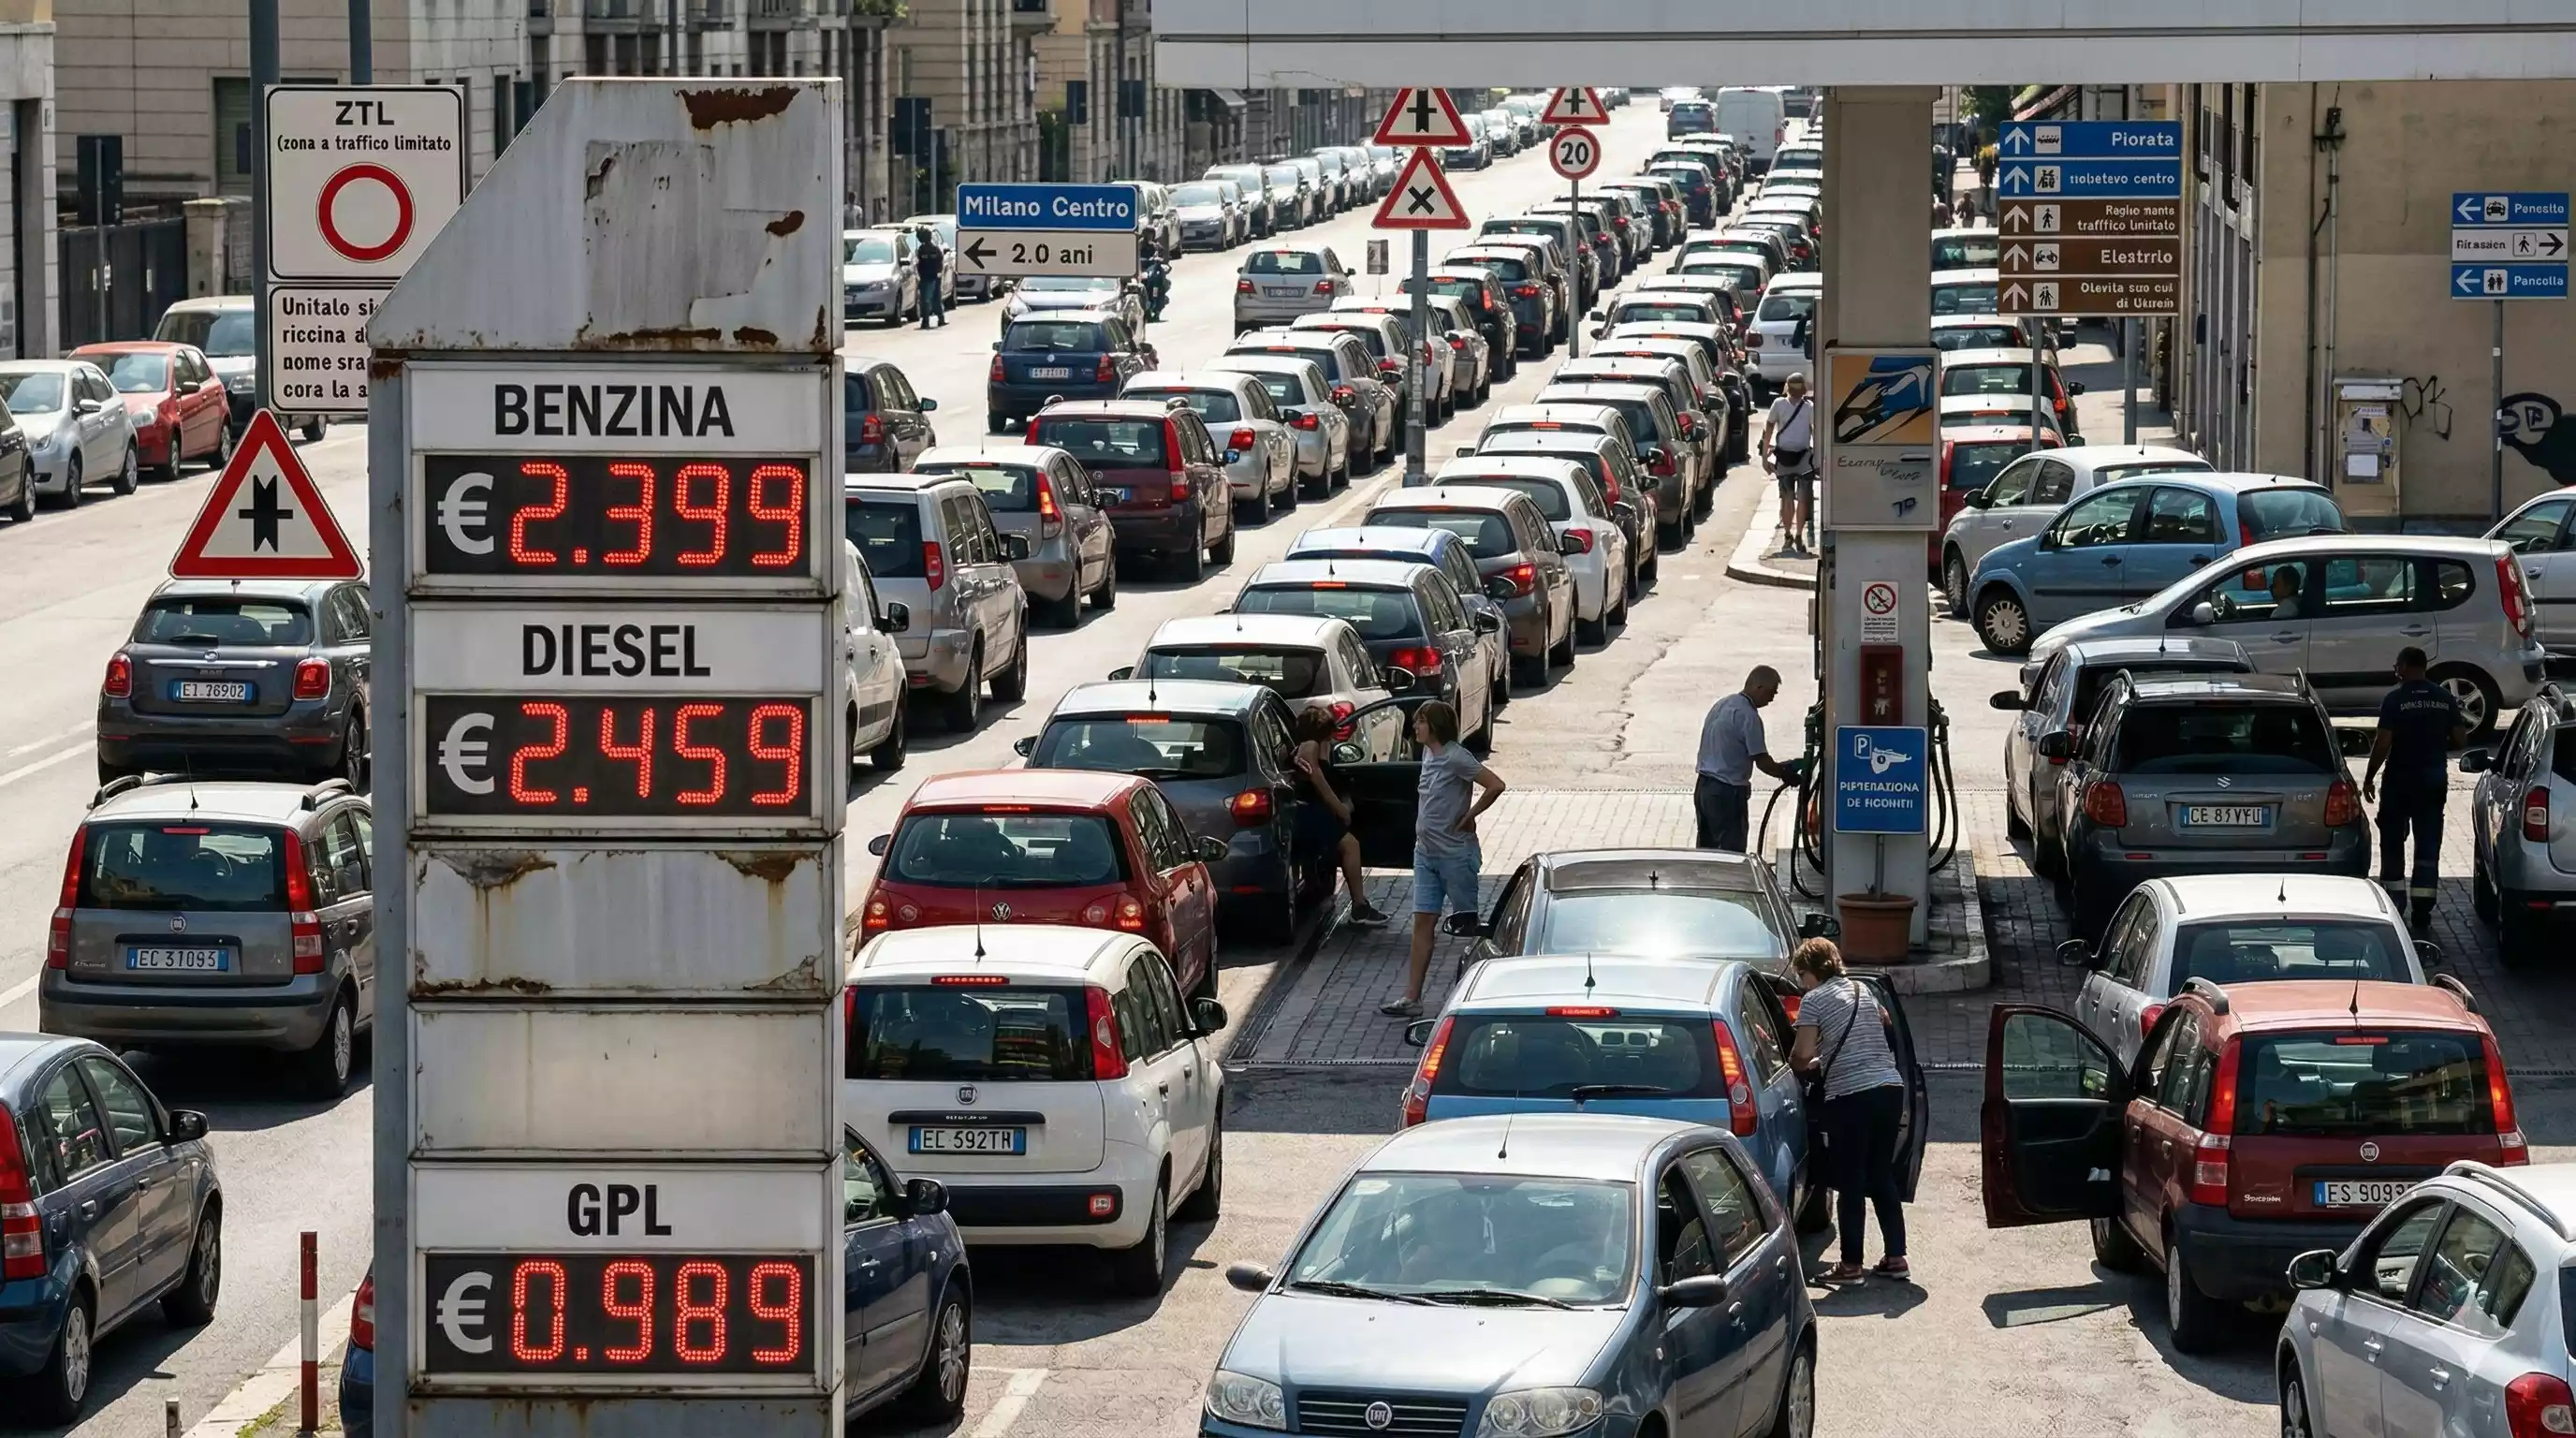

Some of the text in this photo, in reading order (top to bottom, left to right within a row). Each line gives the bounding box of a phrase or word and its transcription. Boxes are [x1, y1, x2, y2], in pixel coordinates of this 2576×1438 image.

[335, 101, 394, 125] ZTL
[277, 135, 451, 152] (zona a traffico limitato
[2112, 131, 2174, 146] Piorata
[1560, 142, 1588, 165] 20
[2133, 172, 2175, 184] centro
[965, 196, 1129, 217] Milano Centro
[1011, 242, 1092, 264] 2.0 ani
[283, 297, 378, 315] Unitalo si
[283, 324, 345, 344] riccina
[284, 383, 323, 398] cora
[332, 379, 349, 398] la
[494, 384, 735, 437] BENZINA
[437, 463, 803, 565] € 2.399
[522, 624, 710, 677] DIESEL
[438, 703, 803, 804] € 2.459
[2190, 807, 2208, 823] CE
[139, 950, 216, 967] EC 31093
[923, 1130, 945, 1149] EC
[2328, 1184, 2351, 1203] ES
[567, 1183, 672, 1237] GPL
[436, 1261, 802, 1362] € 0.989
